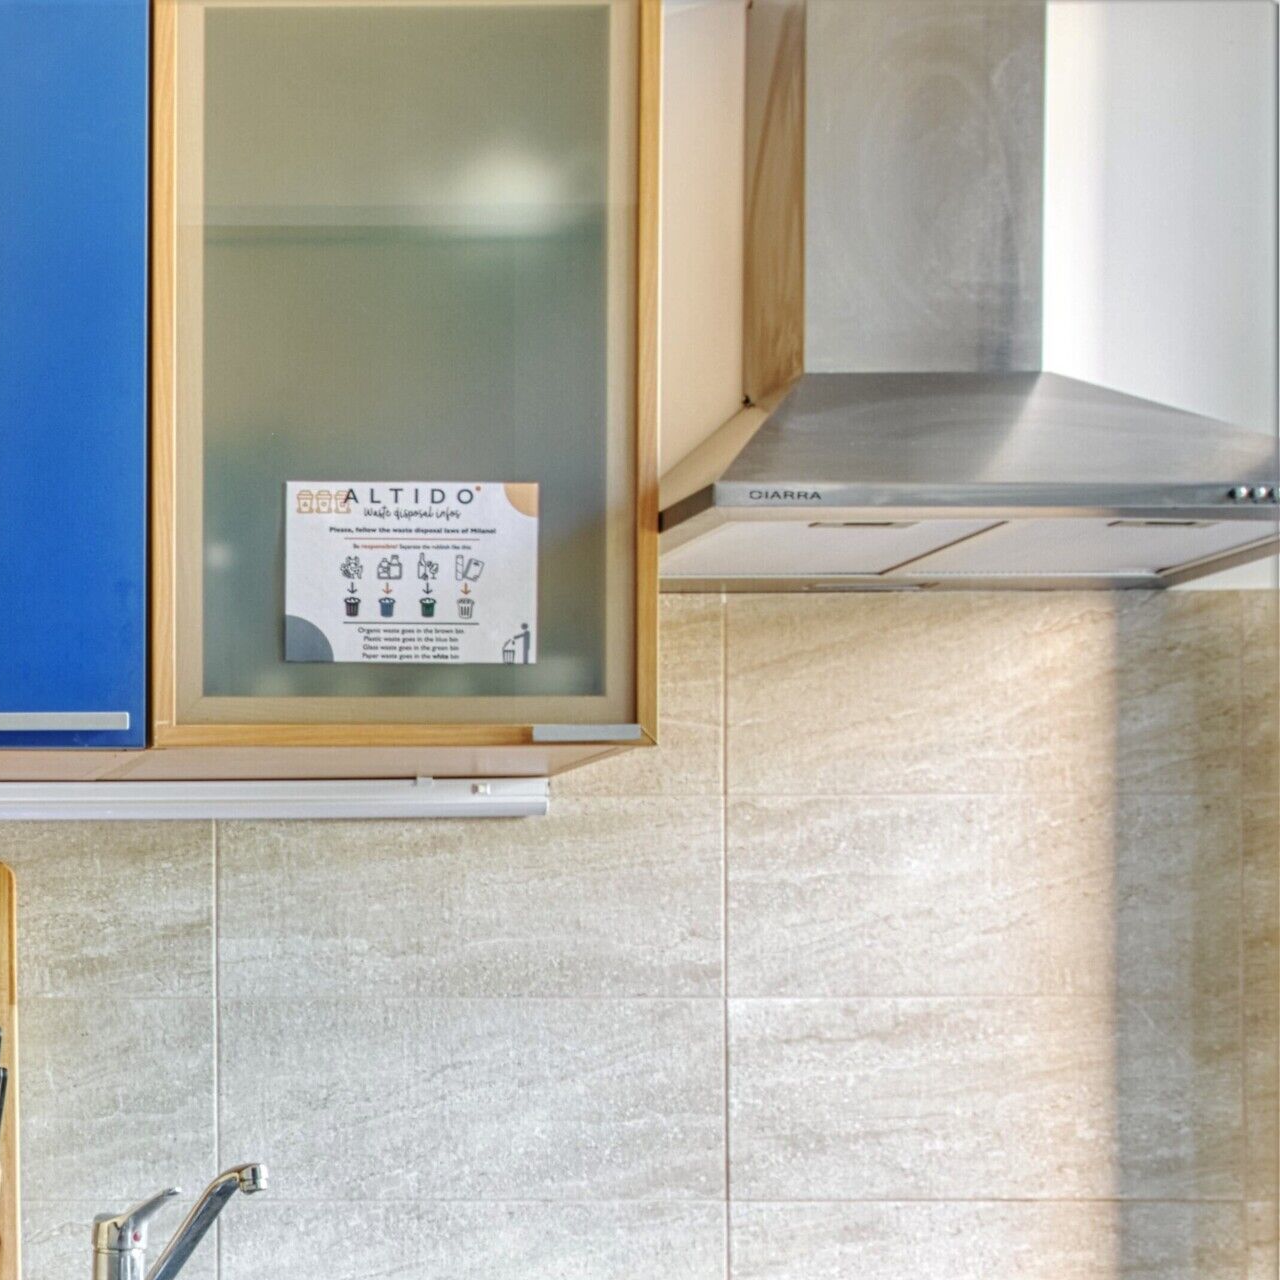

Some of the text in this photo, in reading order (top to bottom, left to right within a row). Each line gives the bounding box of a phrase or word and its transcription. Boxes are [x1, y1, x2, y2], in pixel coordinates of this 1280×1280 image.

[343, 488, 474, 504] ALTIDO
[748, 490, 822, 500] CIARRA
[364, 506, 461, 520] Waste disposal infos
[415, 527, 442, 535] disposal
